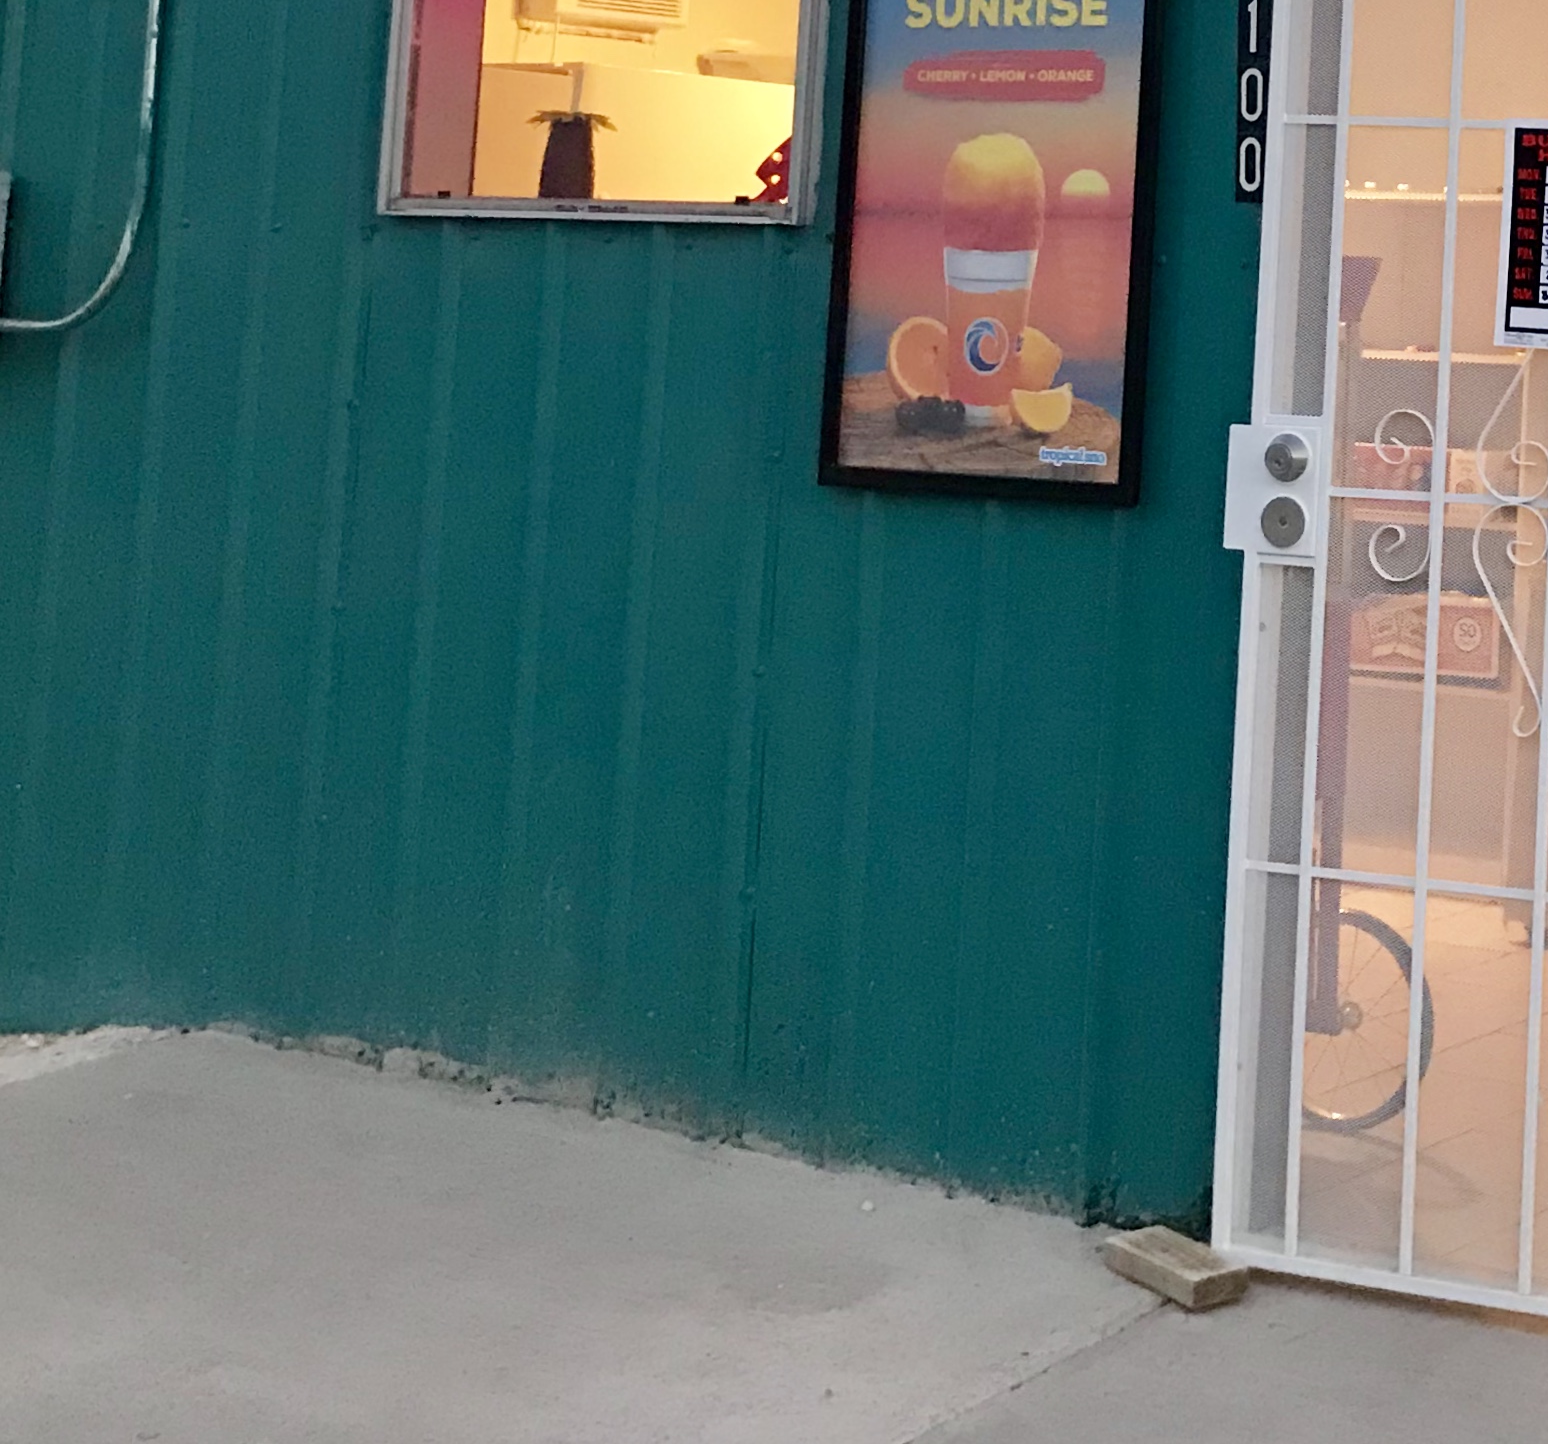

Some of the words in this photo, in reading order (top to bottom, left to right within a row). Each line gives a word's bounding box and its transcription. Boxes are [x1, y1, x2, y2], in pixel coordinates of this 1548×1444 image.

[917, 69, 969, 83] CHERRY
[980, 69, 1026, 83] LEMON
[1037, 69, 1094, 83] ORANGE
[1239, 0, 1264, 192] 100
